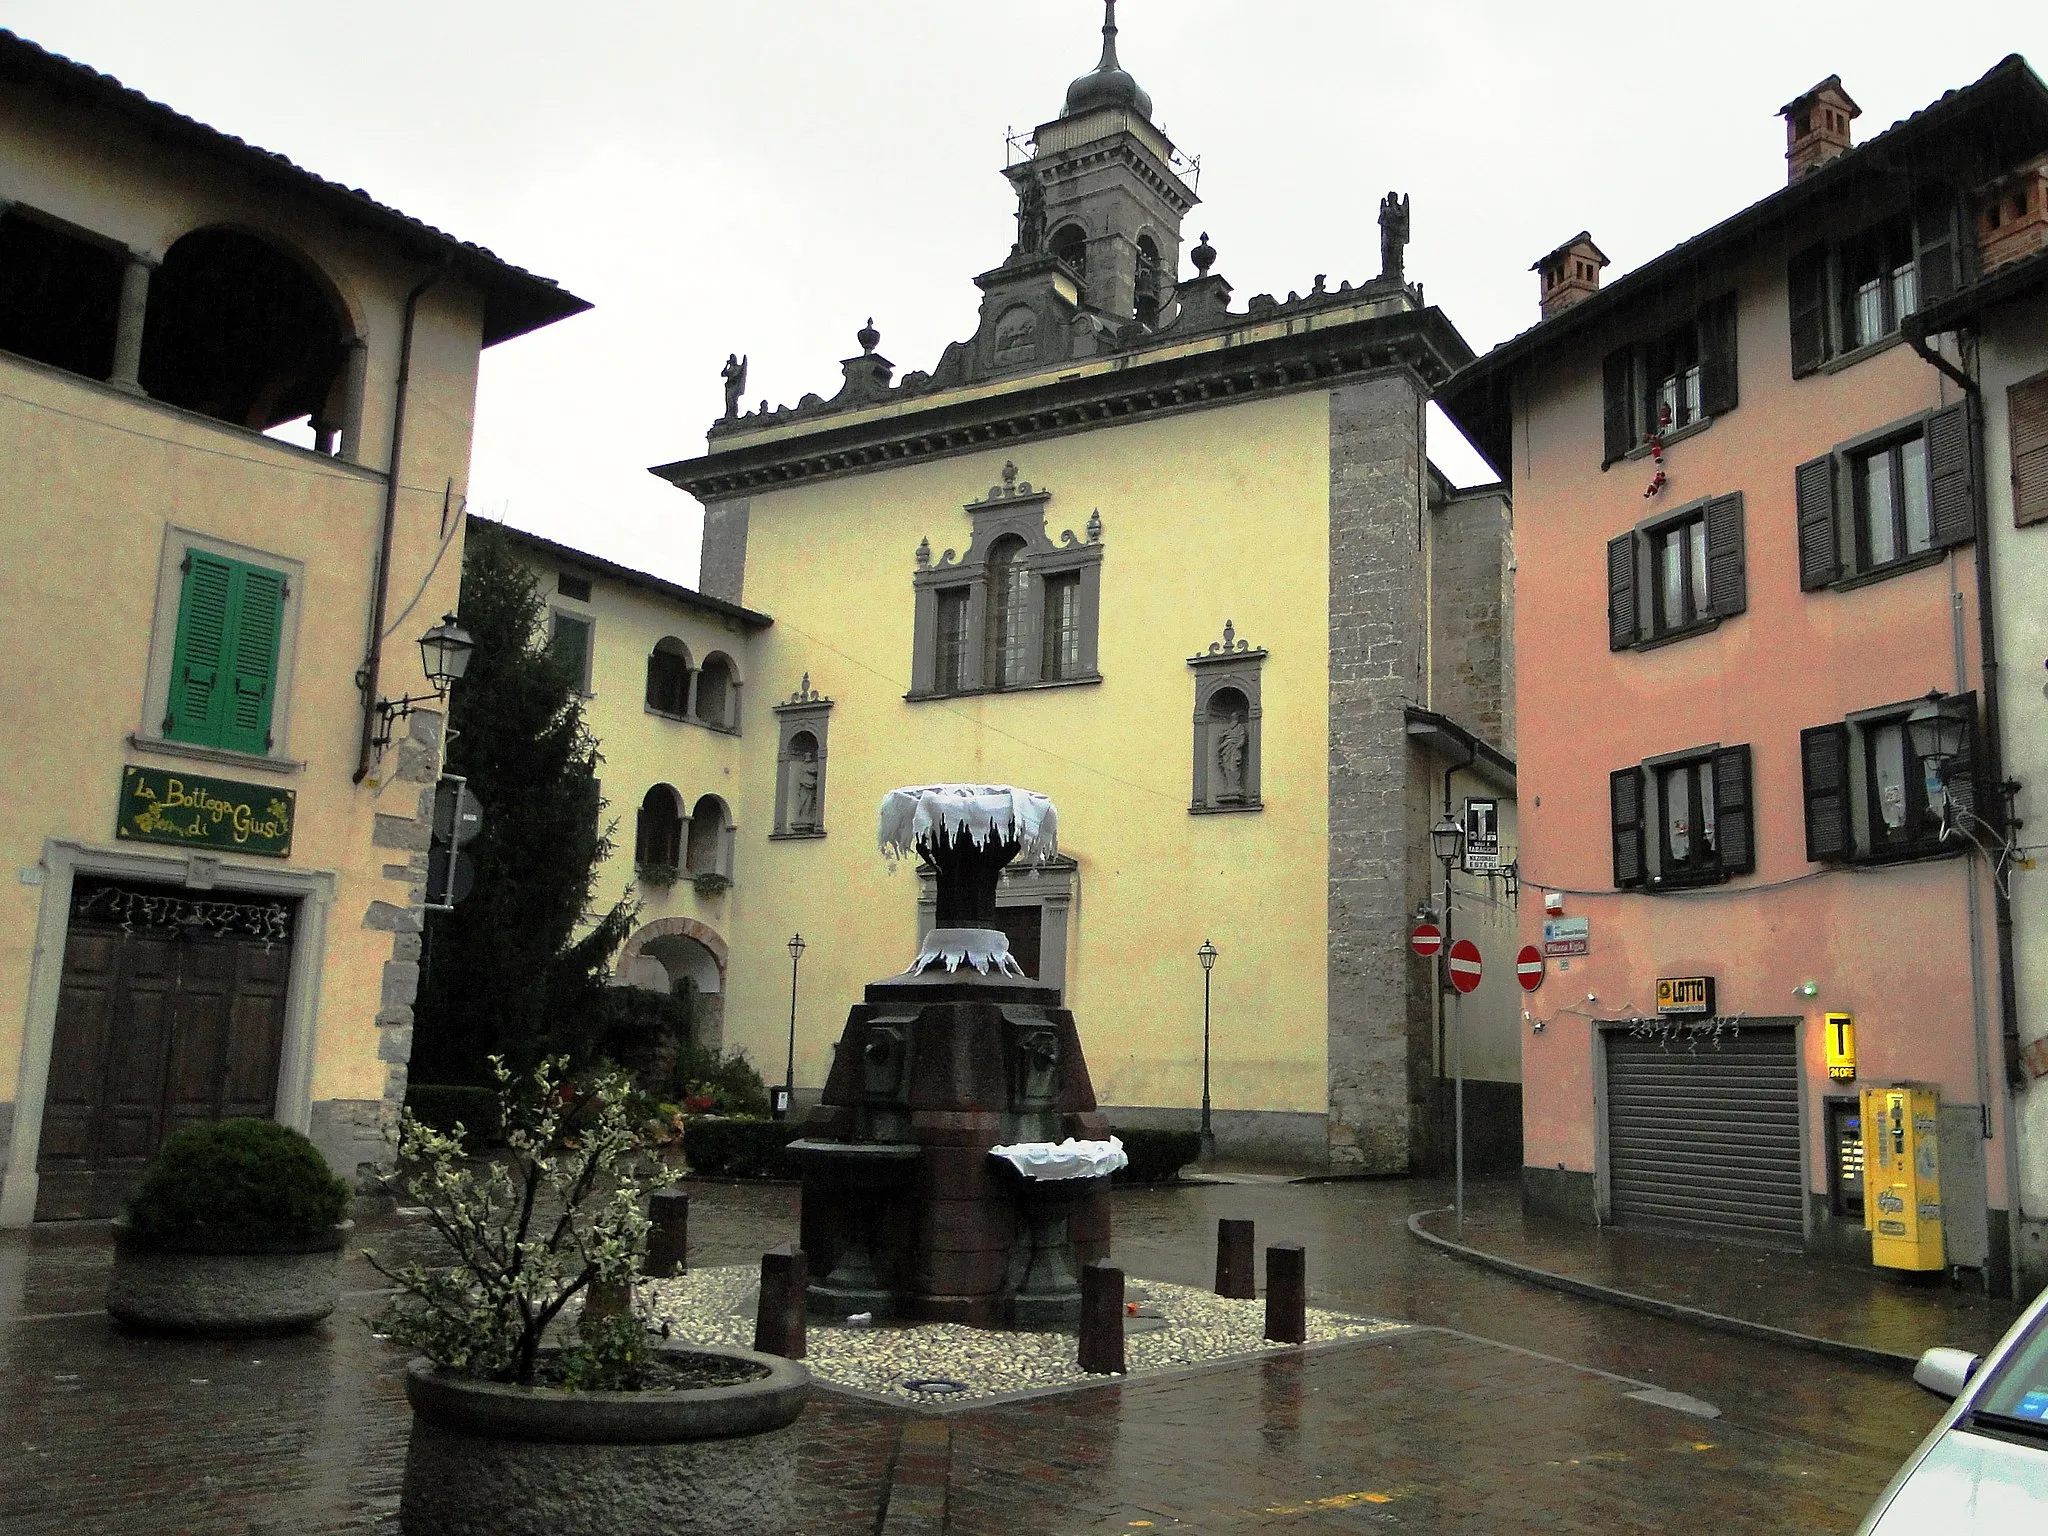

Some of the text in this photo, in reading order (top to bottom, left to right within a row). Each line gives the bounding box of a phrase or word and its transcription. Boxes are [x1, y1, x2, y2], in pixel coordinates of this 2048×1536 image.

[134, 777, 233, 823] La Bottega
[189, 804, 287, 843] di Giusi
[1471, 803, 1493, 841] T
[1673, 980, 1704, 1002] LOTTO
[1830, 1019, 1851, 1055] T
[1830, 1068, 1840, 1078] 24
